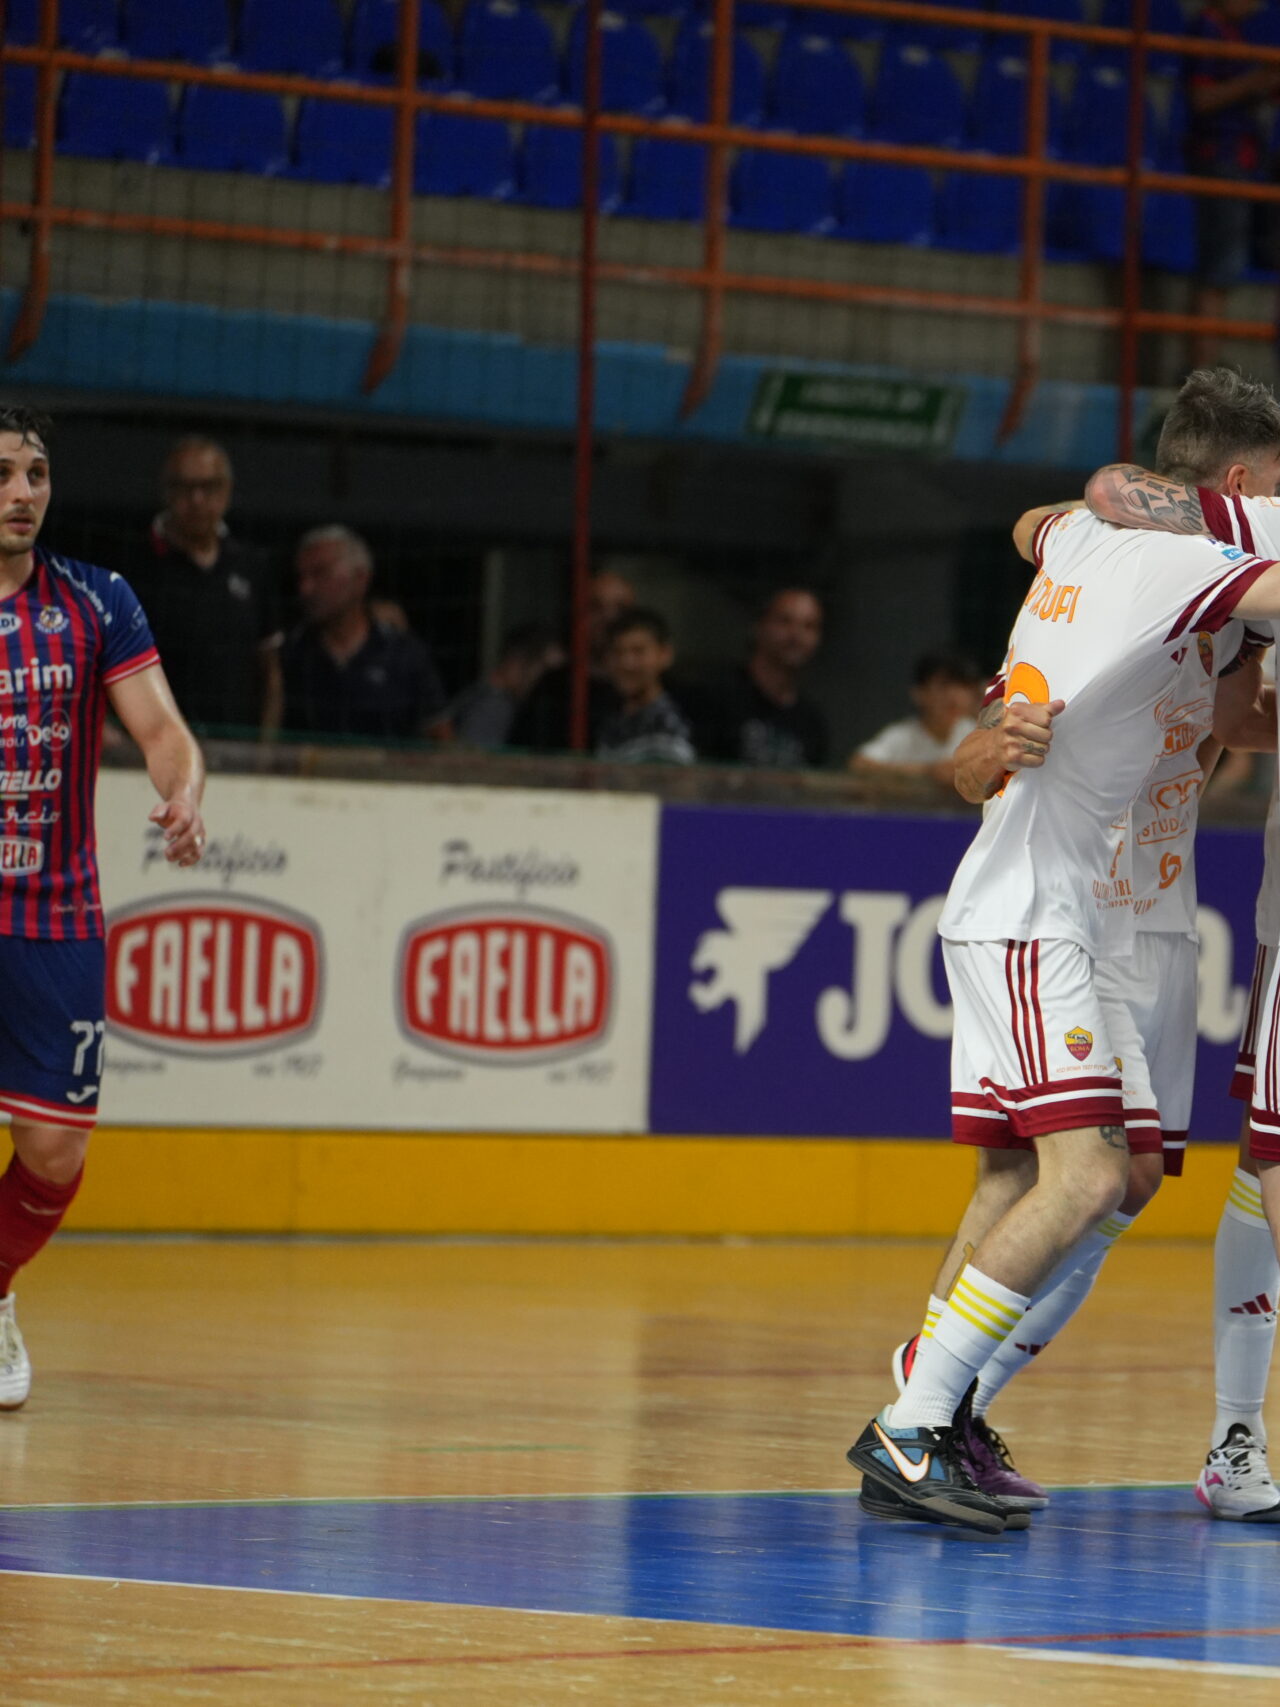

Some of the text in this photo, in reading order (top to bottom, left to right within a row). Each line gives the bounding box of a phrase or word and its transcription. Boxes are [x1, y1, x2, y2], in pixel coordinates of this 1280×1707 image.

[1142, 812, 1189, 838] STUD
[114, 916, 303, 1034] FAELLA
[415, 928, 596, 1042] FAELLA
